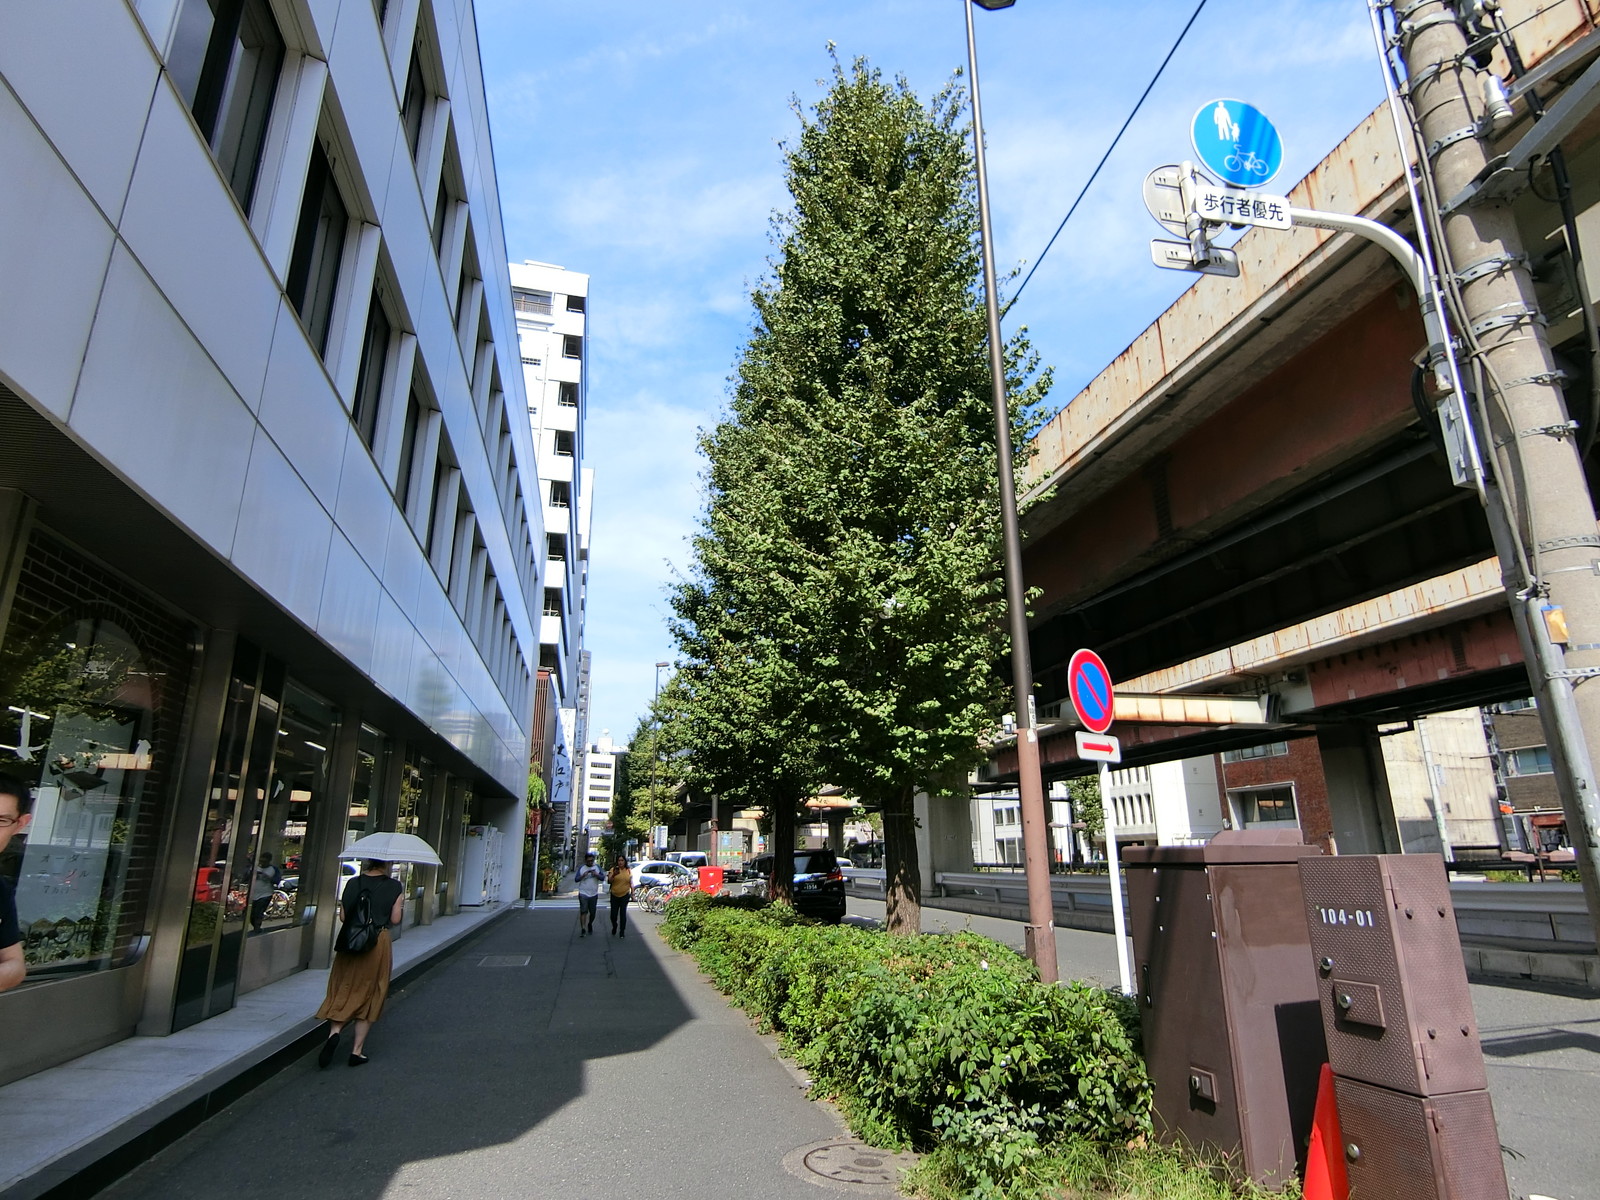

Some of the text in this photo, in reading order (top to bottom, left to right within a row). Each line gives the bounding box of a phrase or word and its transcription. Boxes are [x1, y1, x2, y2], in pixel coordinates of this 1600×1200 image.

[1204, 193, 1283, 222] 歩行者優先
[554, 743, 567, 799] 大江戸
[1320, 908, 1373, 927] 104-01
